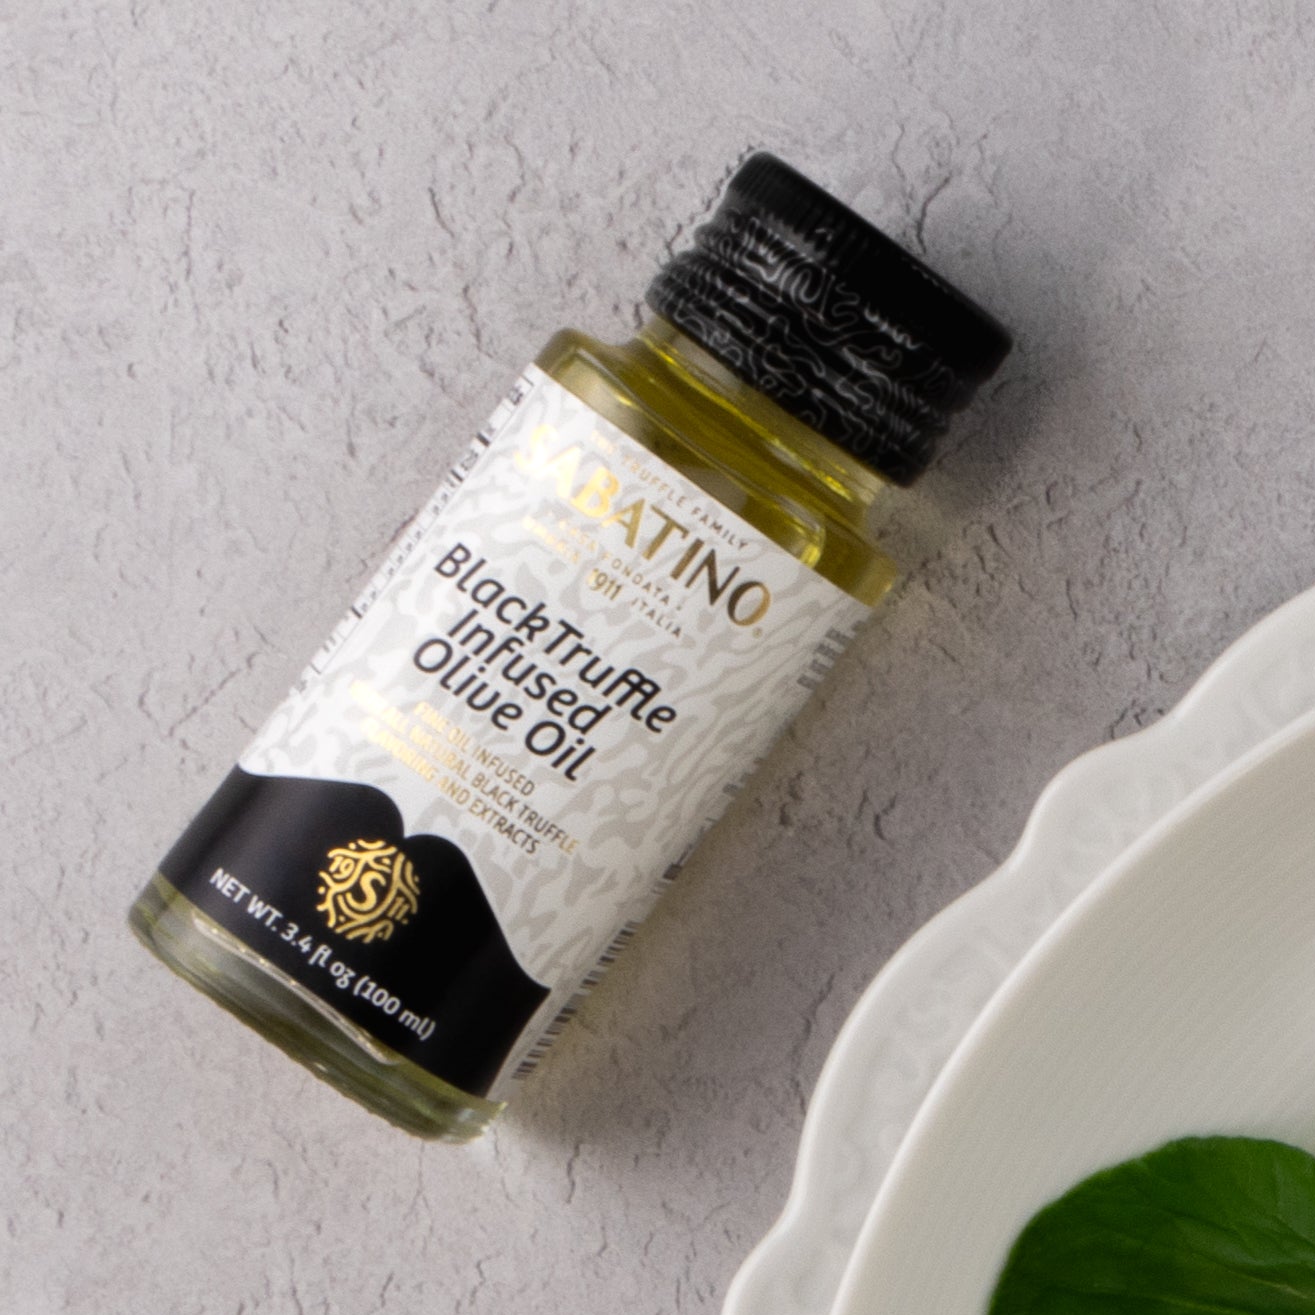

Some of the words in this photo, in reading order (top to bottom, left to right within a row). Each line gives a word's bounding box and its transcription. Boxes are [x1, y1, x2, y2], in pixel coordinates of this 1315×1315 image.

[622, 455, 686, 507] TRUFFLE
[691, 506, 749, 550] FAMILY
[601, 551, 671, 606] FONDATA
[631, 597, 683, 638] ITALIA
[434, 542, 550, 643] Black
[543, 619, 677, 734] Truffle
[447, 608, 613, 735] Infused
[413, 638, 523, 731] Olive
[525, 720, 596, 781] Oil
[448, 728, 473, 753] OIL
[471, 746, 536, 796] INFUSED
[438, 775, 471, 806] AND
[468, 799, 541, 855] EXTRACTS
[471, 773, 521, 814] BLACK
[518, 805, 582, 855] TRUFFLE
[329, 856, 355, 879] 19
[346, 871, 387, 912] S
[209, 867, 252, 903] NET
[246, 895, 284, 931] WT.
[281, 922, 314, 953] 3.4
[308, 944, 332, 968] fl
[330, 961, 356, 989] oz
[353, 975, 400, 1015] (100
[398, 1010, 437, 1042] ml)
